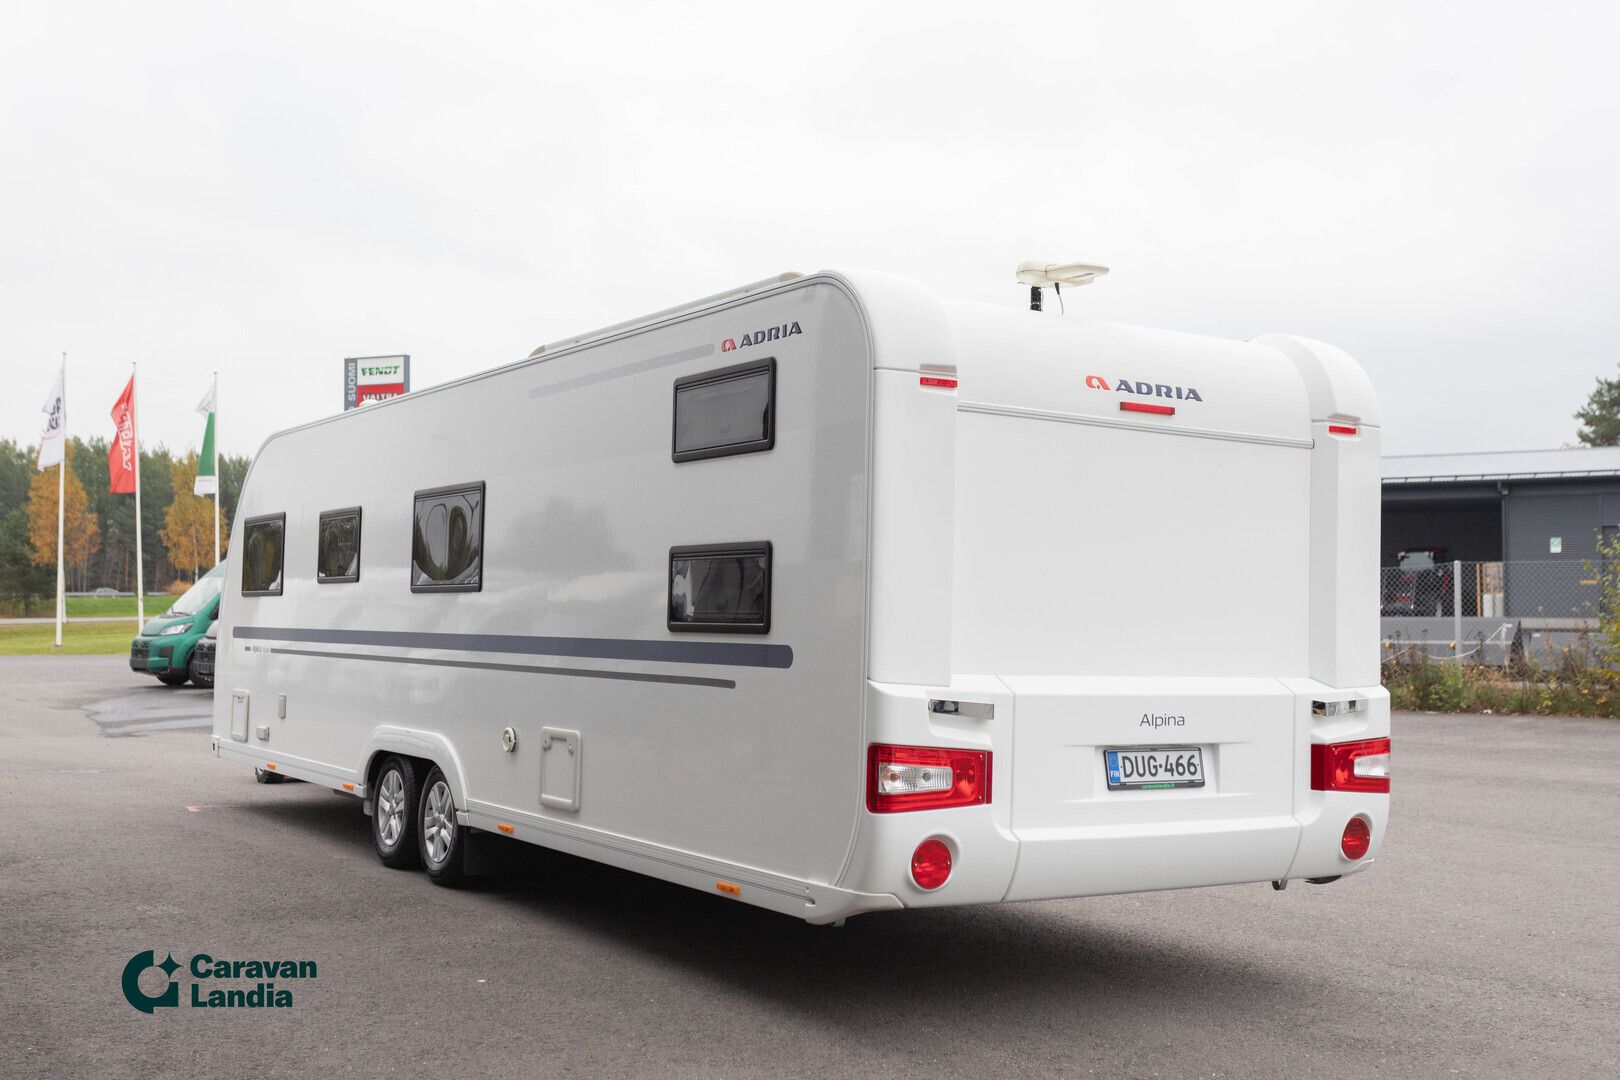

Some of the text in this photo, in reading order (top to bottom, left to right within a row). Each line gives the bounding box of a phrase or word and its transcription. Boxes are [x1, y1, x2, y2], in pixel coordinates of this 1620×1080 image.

[740, 321, 802, 348] ADRIA
[347, 362, 356, 401] SUOMI
[361, 365, 400, 376] FENDT
[1115, 379, 1203, 402] ADRIA
[1139, 713, 1186, 729] Alpina
[1110, 770, 1120, 778] FIN
[1121, 754, 1198, 778] DUG-466
